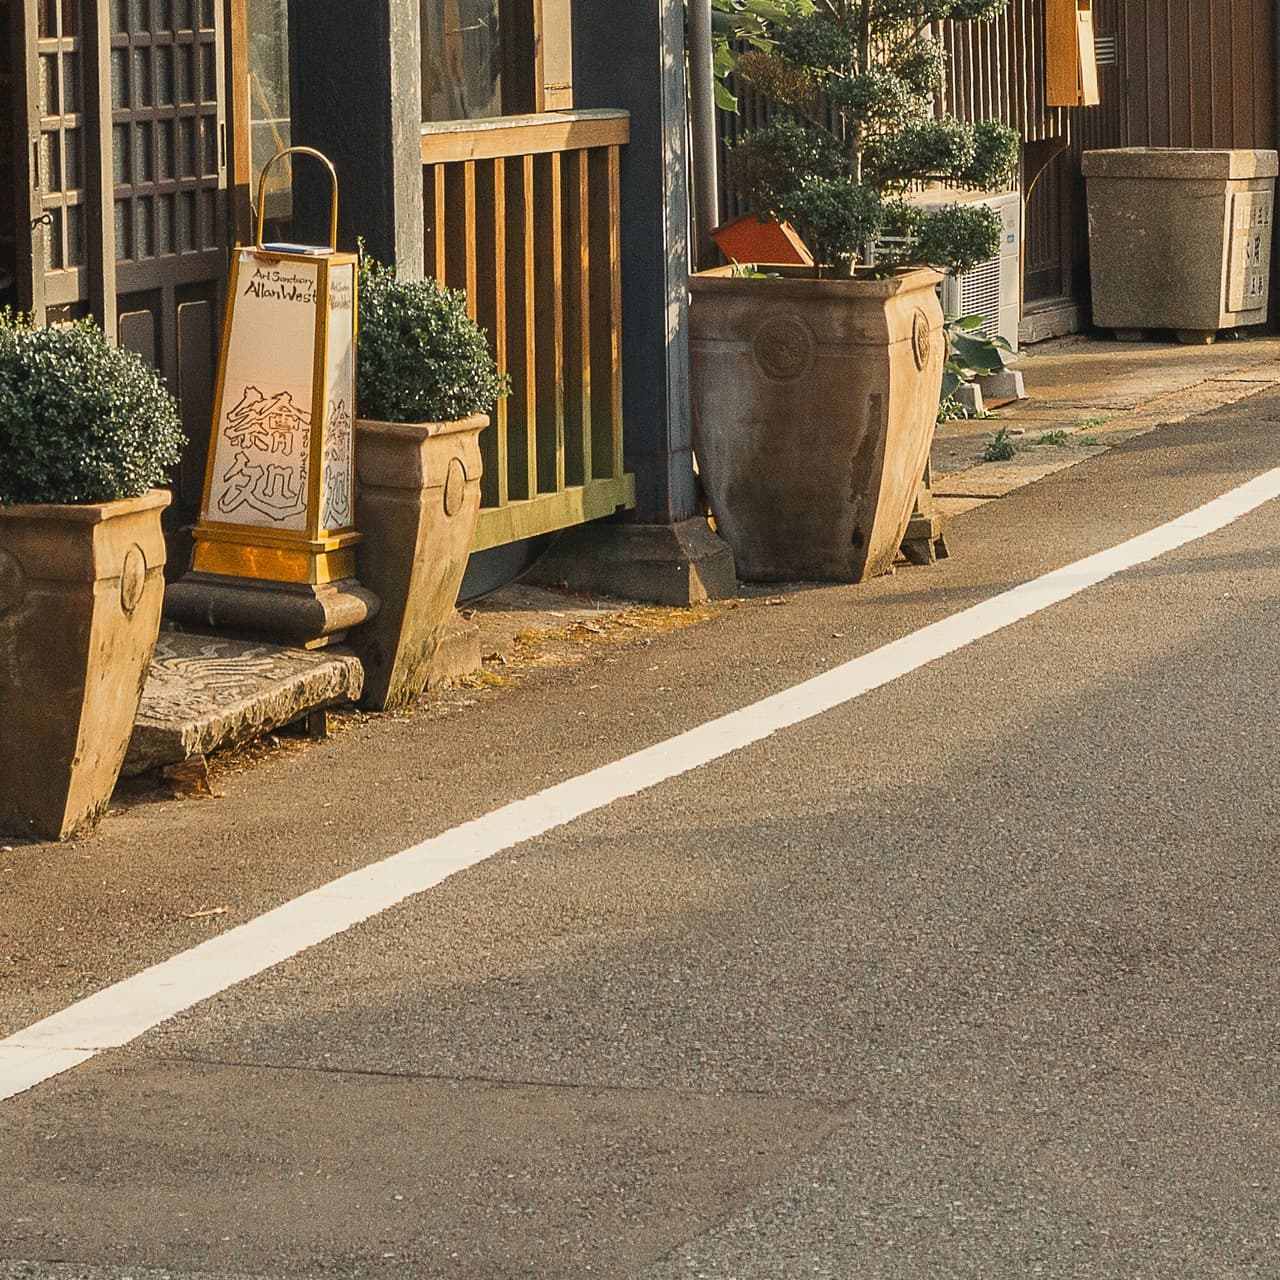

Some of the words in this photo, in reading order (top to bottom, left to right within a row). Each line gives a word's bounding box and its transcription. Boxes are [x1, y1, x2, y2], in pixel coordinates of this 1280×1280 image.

[251, 268, 271, 281] Art
[271, 271, 315, 291] Sanctuary
[244, 280, 280, 300] Allan
[280, 284, 318, 305] West
